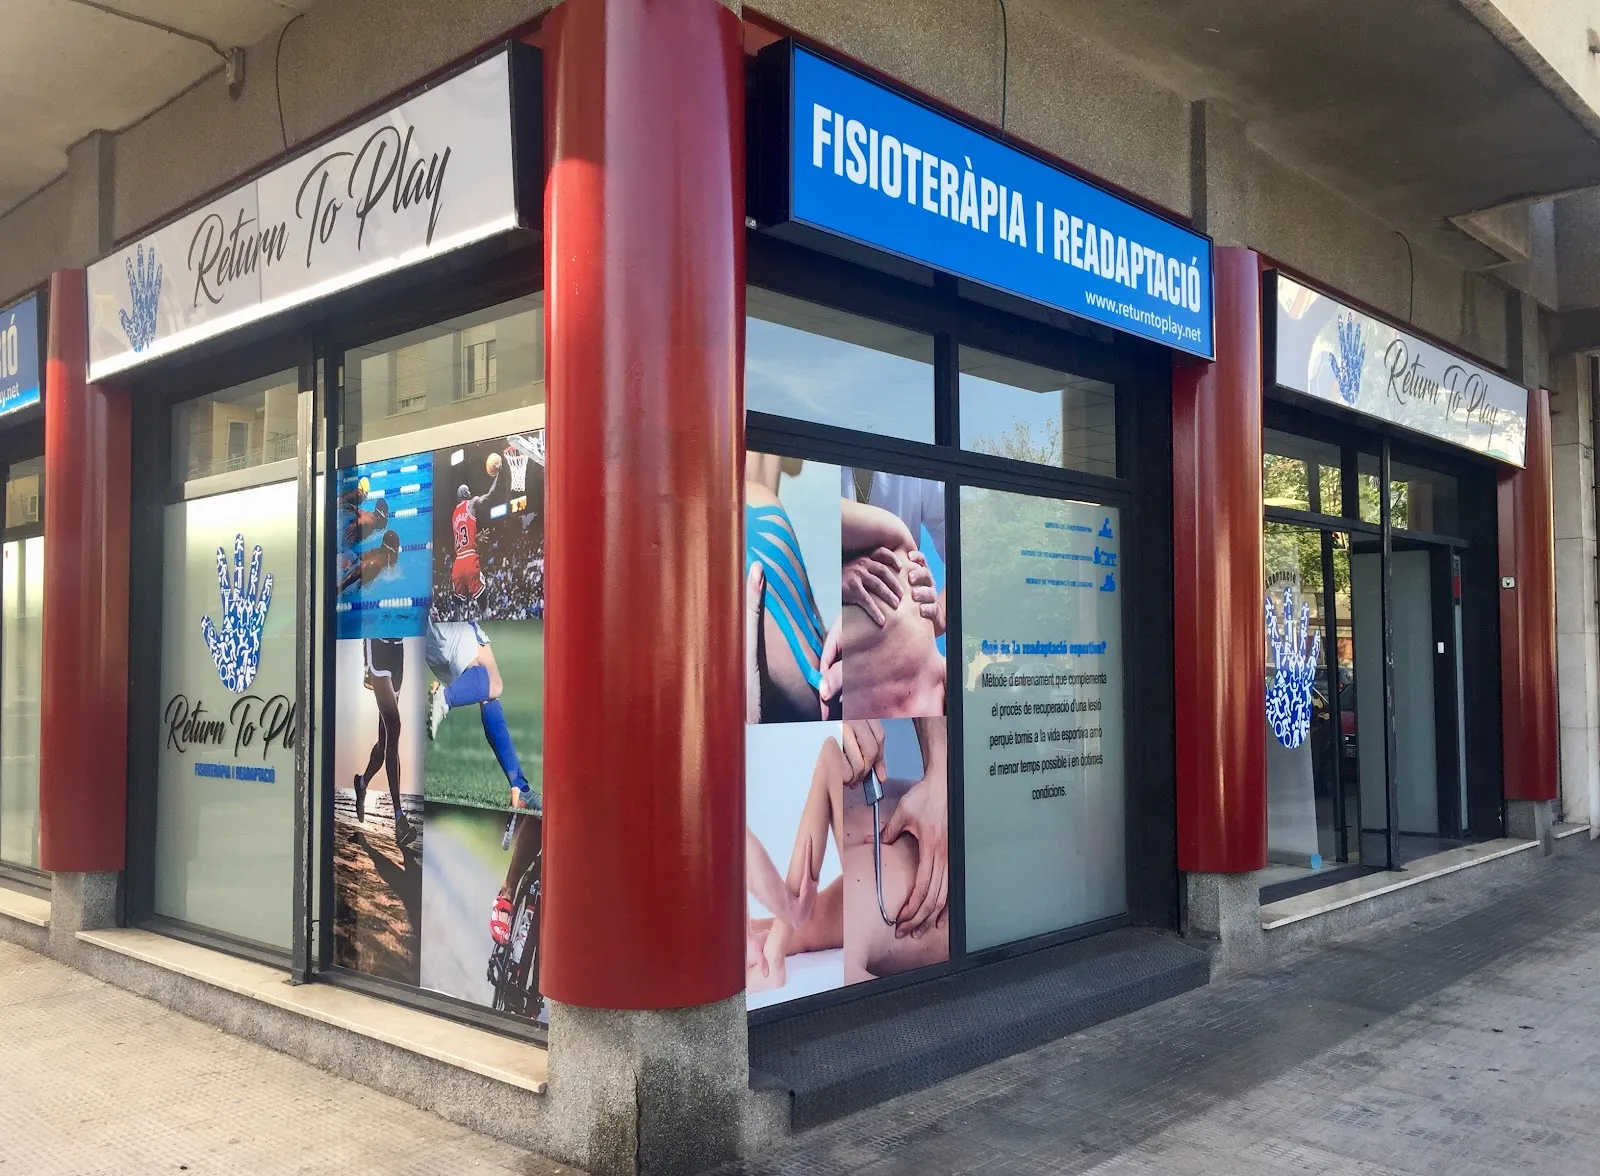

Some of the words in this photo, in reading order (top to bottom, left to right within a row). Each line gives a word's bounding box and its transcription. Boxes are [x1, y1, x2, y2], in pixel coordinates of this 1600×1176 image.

[187, 208, 290, 308] Return
[295, 151, 354, 269] To
[347, 124, 452, 251] Play
[812, 103, 1027, 248] FISIOTERÀPIA
[1036, 201, 1044, 254] I
[1053, 207, 1202, 313] READAPTACIÓ
[1085, 290, 1202, 343] www.returntoplay.net
[1384, 338, 1440, 405] Return
[1443, 364, 1468, 422] To
[1465, 373, 1498, 452] Play
[1055, 675, 1067, 689] que
[164, 694, 227, 754] Return
[229, 694, 265, 758] To
[991, 704, 998, 717] el
[1000, 701, 1022, 719] procés
[1023, 702, 1032, 716] de
[1033, 699, 1070, 718] recuperació
[1034, 734, 1039, 743] a
[1039, 728, 1046, 742] la
[1047, 727, 1061, 742] vida
[989, 763, 997, 777] el
[997, 763, 1020, 776] menor
[1020, 759, 1041, 776] temps
[1071, 757, 1080, 768] en
